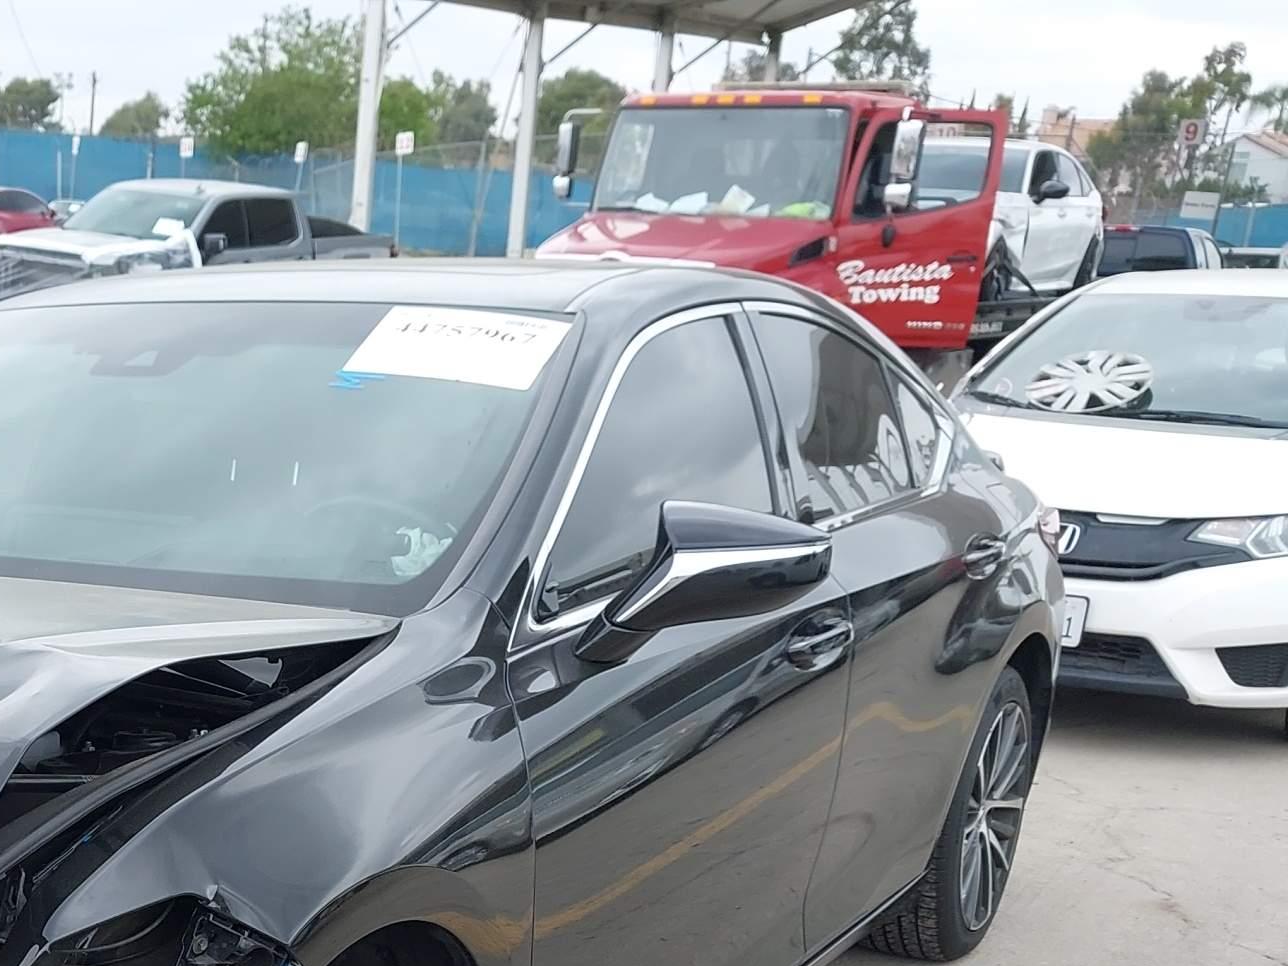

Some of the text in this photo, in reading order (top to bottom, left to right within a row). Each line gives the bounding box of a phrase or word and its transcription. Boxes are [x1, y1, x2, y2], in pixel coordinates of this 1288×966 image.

[1184, 122, 1199, 141] 9
[836, 259, 954, 285] Bautista
[848, 284, 941, 304] Towing
